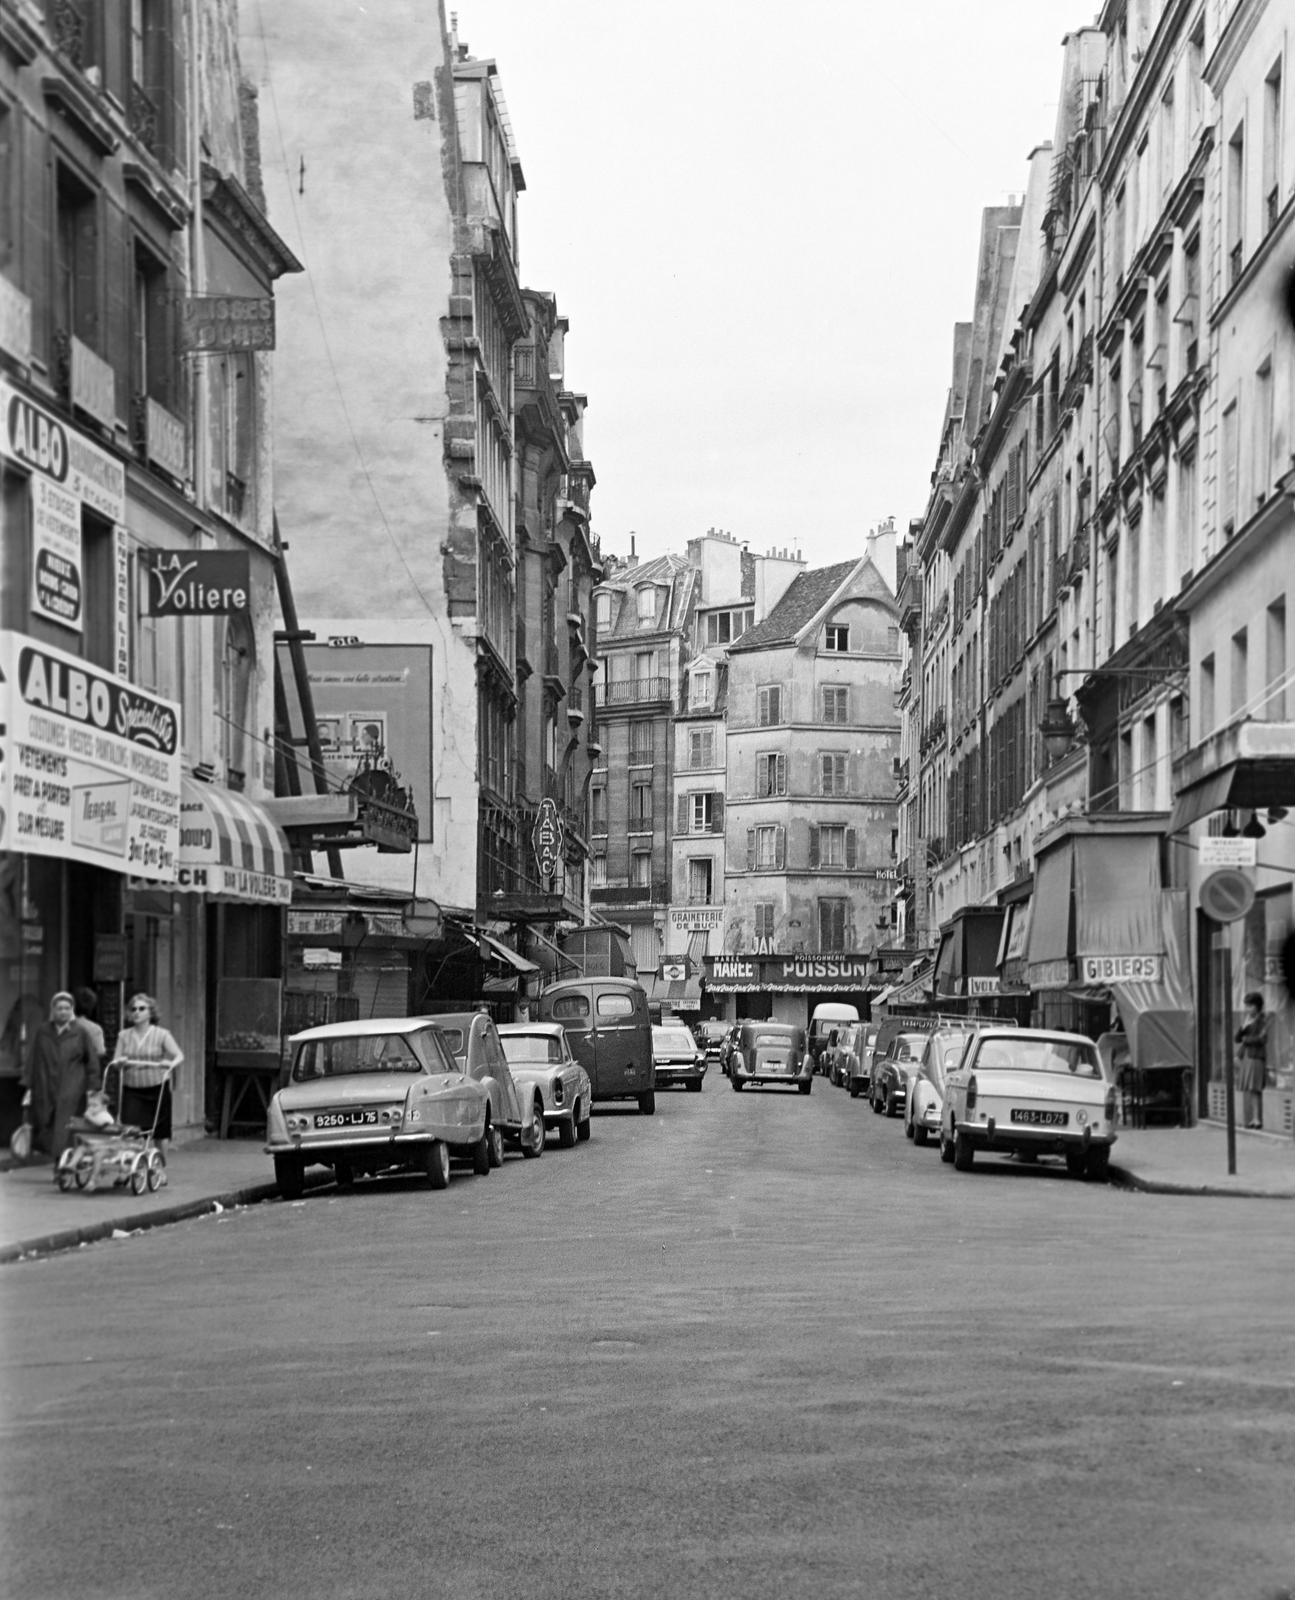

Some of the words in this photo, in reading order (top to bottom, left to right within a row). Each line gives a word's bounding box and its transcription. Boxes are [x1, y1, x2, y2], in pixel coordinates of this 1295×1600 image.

[14, 401, 62, 477] ALBO
[151, 560, 247, 608] Voliere
[158, 554, 181, 571] LA
[118, 622, 127, 675] LIBR
[24, 654, 111, 728] ALBO
[540, 803, 555, 874] TABAC
[672, 912, 723, 922] GRAINETERIE
[751, 937, 777, 955] JAN
[1087, 959, 1154, 979] GIBIERS
